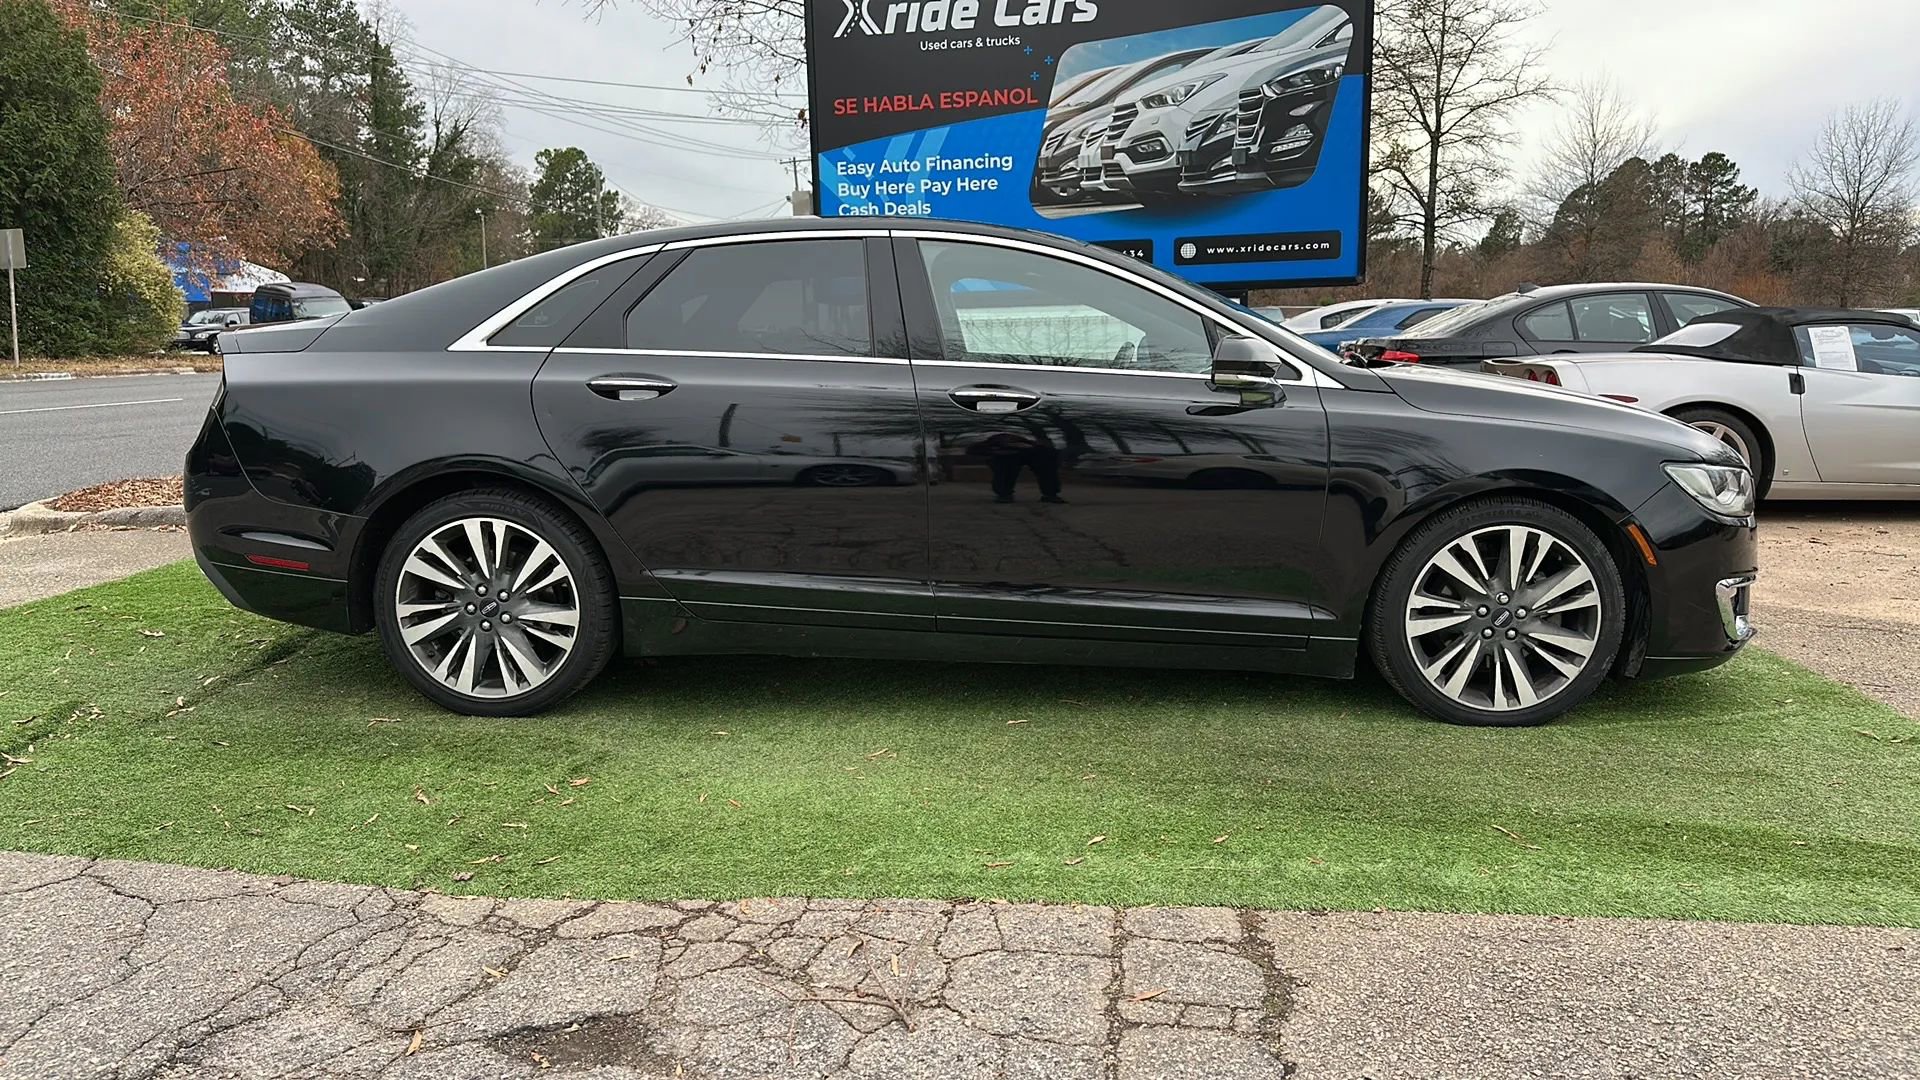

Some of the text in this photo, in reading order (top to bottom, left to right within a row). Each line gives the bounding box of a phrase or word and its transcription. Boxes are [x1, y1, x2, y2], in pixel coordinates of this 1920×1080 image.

[920, 36, 1021, 51] Used cars & trucks
[834, 88, 1038, 115] SE HABLA ESPANOL
[837, 153, 1013, 178] Easy Auto Financing
[838, 177, 999, 199] Buy Here Pay Here
[838, 200, 932, 216] Cash Deals
[1206, 241, 1330, 254] www.xridecars.com
